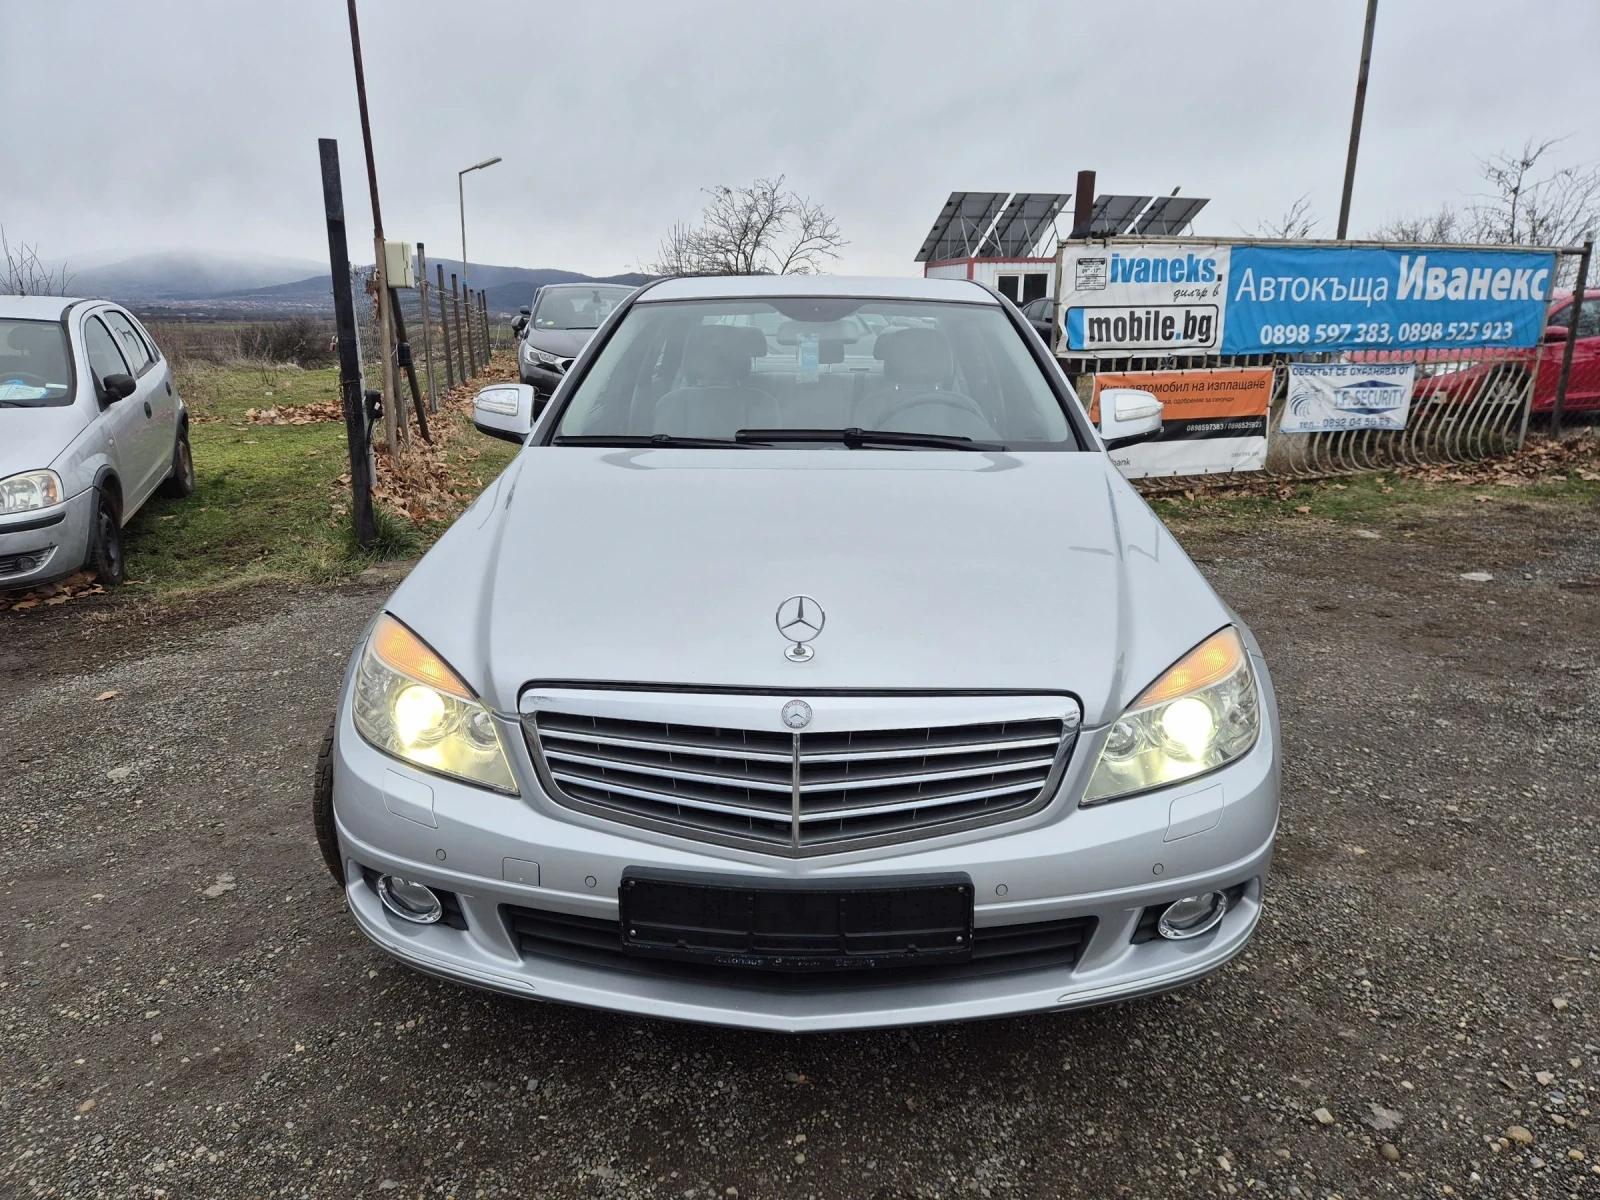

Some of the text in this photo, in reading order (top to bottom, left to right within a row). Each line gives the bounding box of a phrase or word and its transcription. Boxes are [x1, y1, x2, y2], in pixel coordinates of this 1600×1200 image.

[1396, 255, 1549, 301] Иванекс
[1088, 310, 1212, 343] mobile.bg
[1260, 321, 1513, 345] 0898 597 383, 0898 525 923
[1336, 367, 1347, 377] СЕ
[1399, 366, 1410, 375] ОТ
[1192, 382, 1205, 391] на
[1207, 380, 1266, 391] изплащане
[1352, 388, 1407, 407] SECURITY
